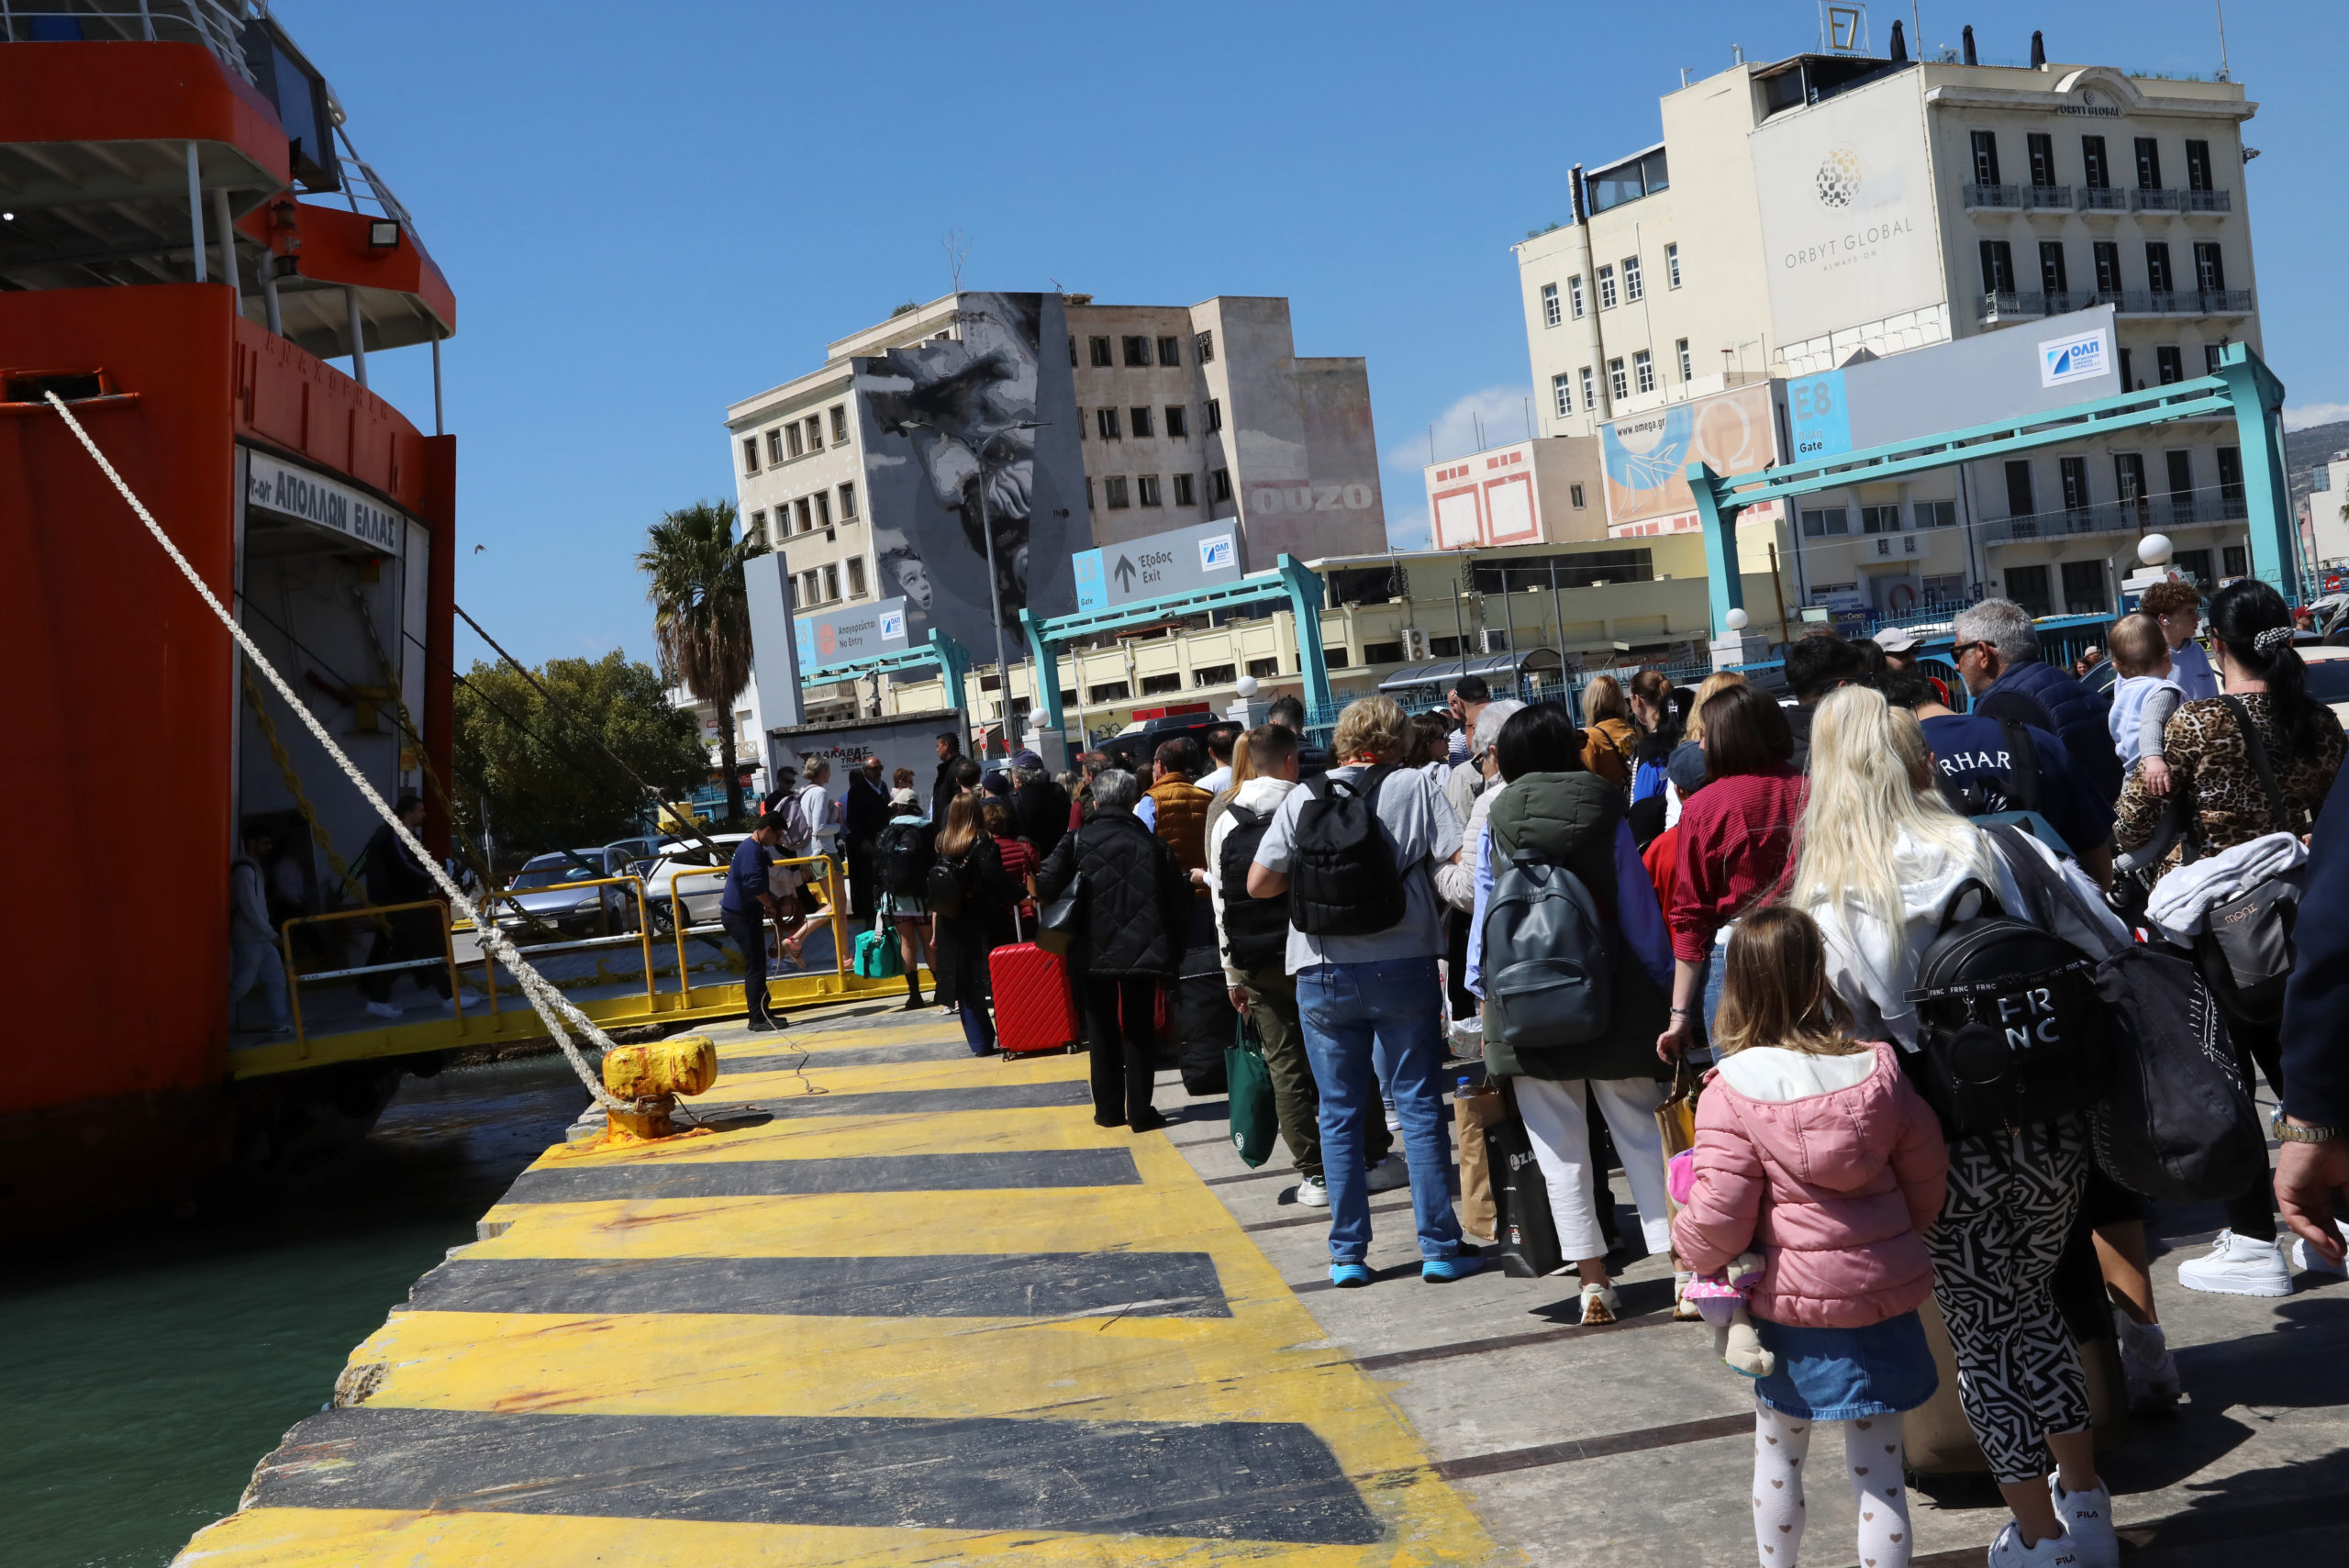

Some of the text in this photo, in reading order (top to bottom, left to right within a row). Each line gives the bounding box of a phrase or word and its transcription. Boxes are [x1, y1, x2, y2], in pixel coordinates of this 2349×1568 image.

[1829, 6, 1859, 50] E7
[1785, 217, 1914, 269] ORBYT GLOBAL
[1823, 250, 1877, 272] ALWAYS ON
[2070, 340, 2099, 357] ΟΛΠ
[1793, 381, 1832, 422] E8
[1616, 417, 1666, 438] www.omega.gr
[1798, 439, 1823, 454] Gate
[1251, 484, 1374, 515] OUZO
[1138, 550, 1174, 569] Έξοδος
[1075, 555, 1097, 584] E8
[1142, 570, 1162, 584] Exit
[1080, 597, 1094, 606] Gate
[839, 636, 864, 649] No Entry
[1929, 987, 1945, 996] FRNC
[1950, 984, 1969, 994] FRNC
[1976, 982, 1997, 992] FRNC
[2005, 1016, 2060, 1051] NC
[2076, 1510, 2099, 1519] FILA
[2054, 1553, 2076, 1567] FILA
